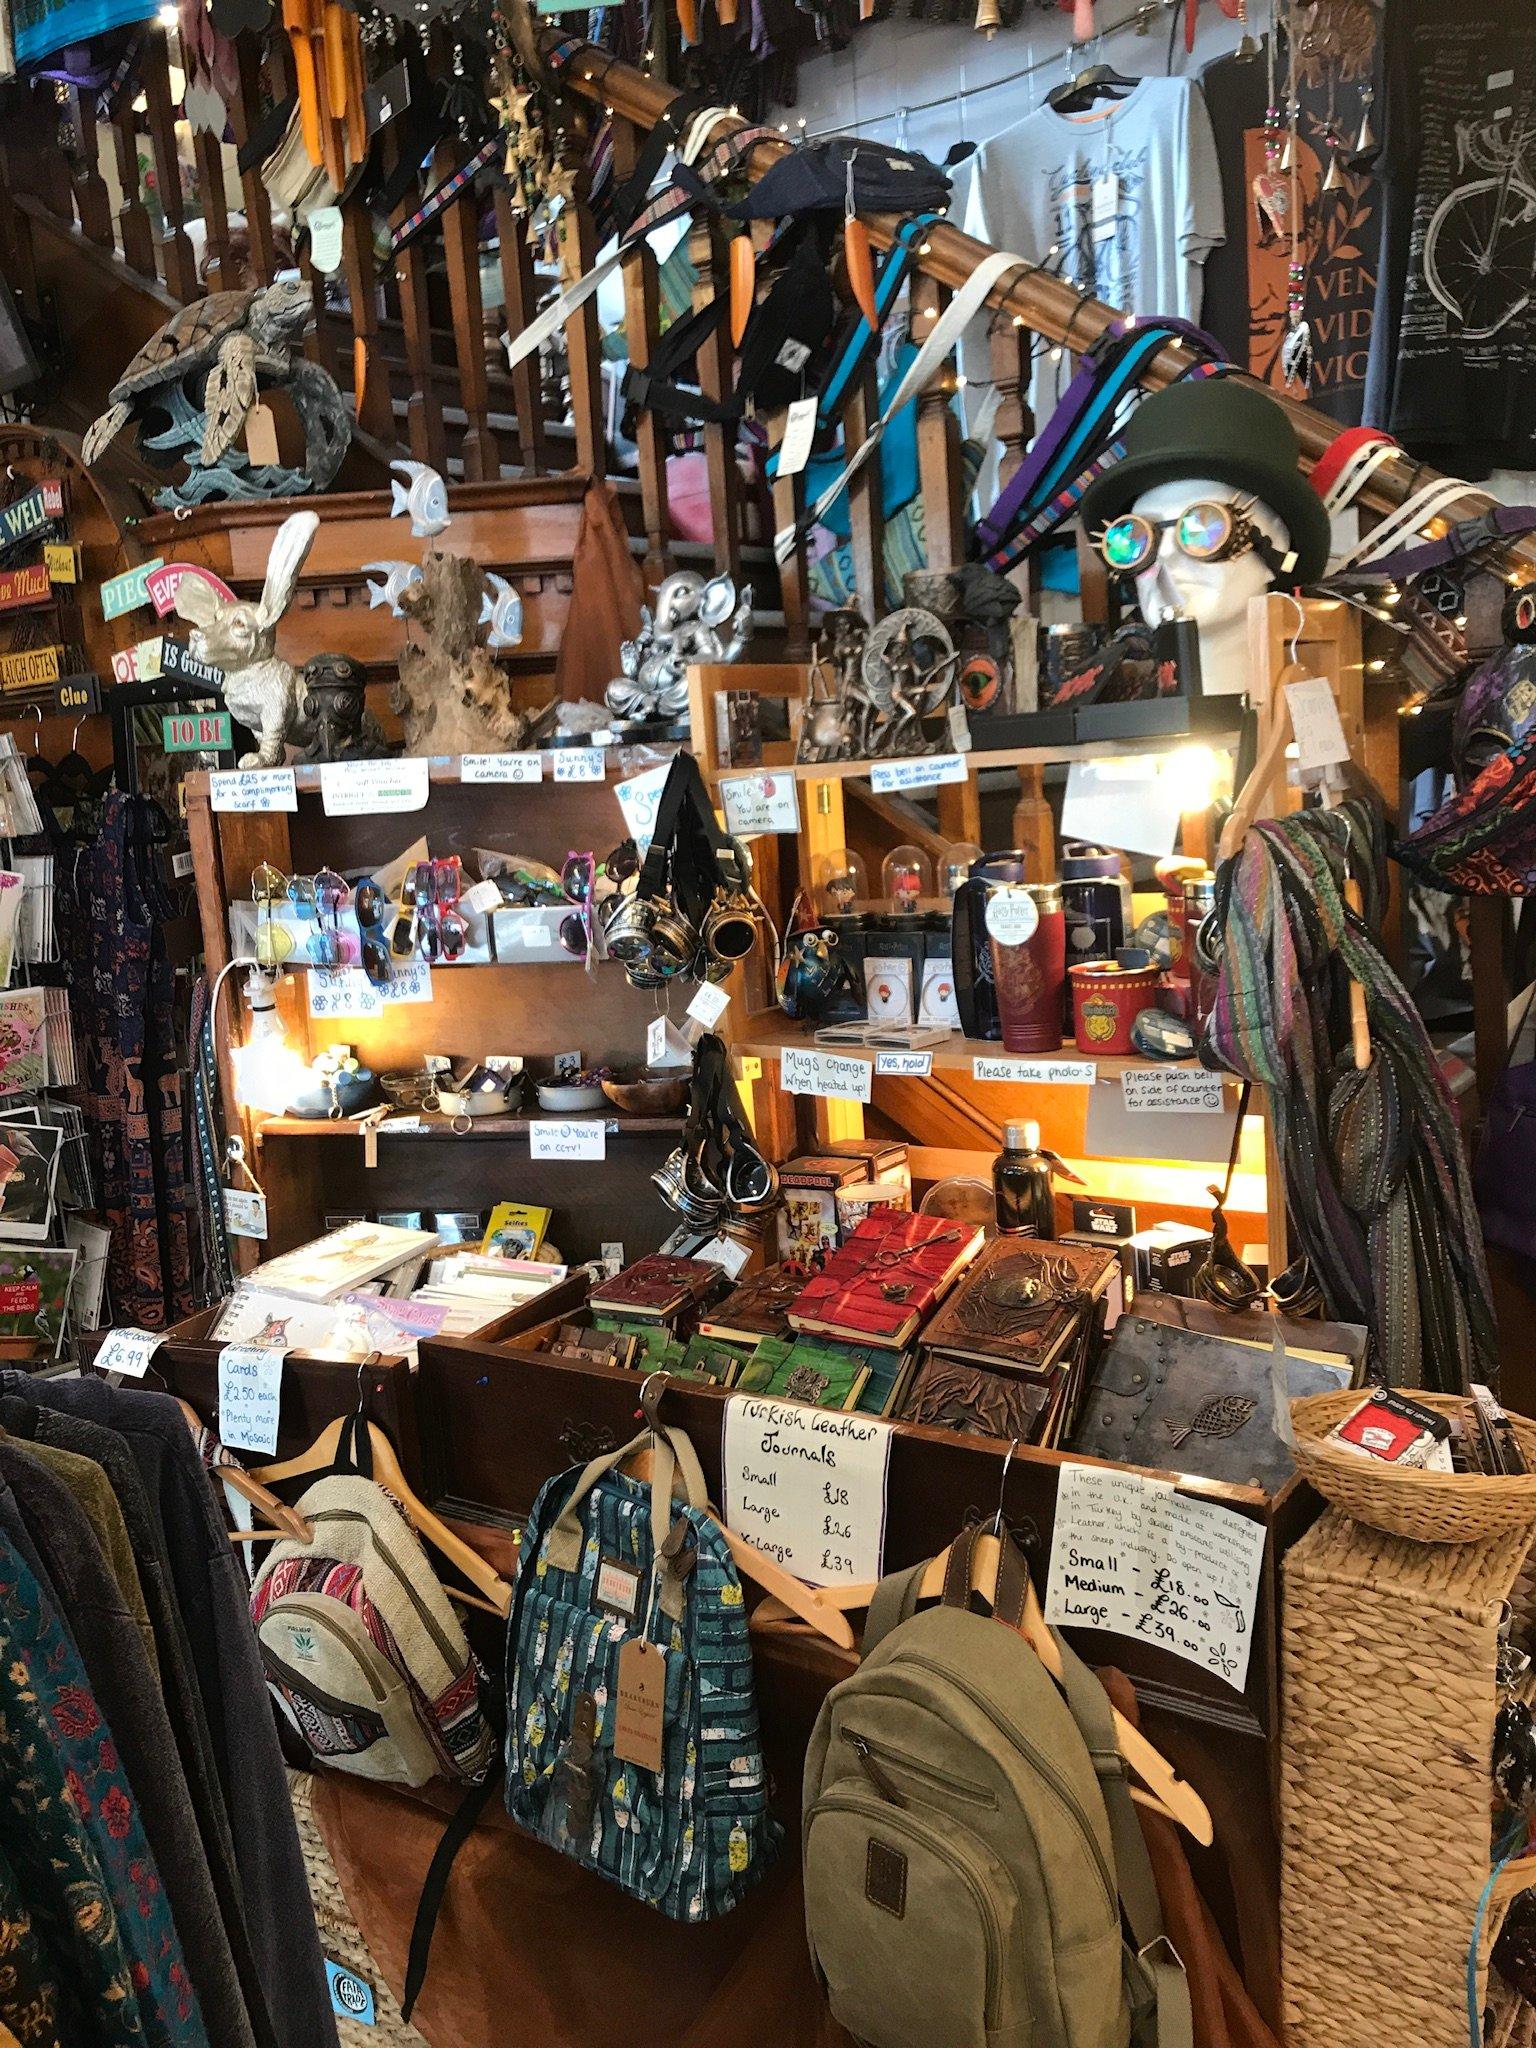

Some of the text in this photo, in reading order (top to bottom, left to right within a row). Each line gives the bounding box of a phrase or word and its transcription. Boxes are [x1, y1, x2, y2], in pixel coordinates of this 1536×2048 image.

[1314, 266, 1377, 300] VEN
[1314, 308, 1374, 343] VID
[1314, 350, 1370, 385] VIC
[14, 570, 50, 597] Much
[104, 573, 149, 614] PIEC
[164, 643, 179, 669] IS
[1, 651, 57, 688] LAUGH OFTEN
[60, 687, 88, 707] Clue
[170, 716, 226, 745] TO BE
[527, 759, 540, 767] on
[211, 776, 237, 789] Spend
[239, 773, 259, 786] £25
[273, 773, 292, 782] more
[475, 769, 508, 779] camera
[882, 779, 894, 788] for
[215, 789, 225, 800] for
[736, 801, 790, 815] You are on
[738, 817, 775, 826] camera
[392, 964, 427, 982] unny's
[785, 1051, 866, 1079] Mugs change
[902, 1056, 925, 1069] hold
[977, 1060, 1012, 1078] Please
[1017, 1065, 1042, 1079] take
[785, 1073, 868, 1097] When heated up!
[1125, 1070, 1213, 1085] Please push bell
[1125, 1088, 1138, 1096] on
[1166, 1084, 1179, 1094] of
[1181, 1084, 1222, 1093] counter
[1128, 1097, 1201, 1108] for assistance
[573, 1127, 599, 1140] You're
[540, 1143, 551, 1151] on
[780, 1174, 834, 1188] DEADPOOL
[1091, 1217, 1116, 1227] STAR
[1091, 1224, 1118, 1234] WARS
[1168, 1250, 1192, 1261] STAR
[1168, 1255, 1193, 1268] WARS
[10, 1296, 28, 1304] FEED
[16, 1303, 35, 1311] BIRDS
[100, 1342, 143, 1367] £6.99
[226, 1359, 258, 1377] Cards
[258, 1392, 278, 1401] each
[226, 1409, 275, 1432] Plenty more
[741, 1399, 877, 1441] Turkish Leather
[228, 1432, 237, 1440] in
[761, 1431, 837, 1467] Journals
[742, 1466, 777, 1486] Small
[823, 1482, 850, 1506] £18
[743, 1496, 780, 1523] Large
[1069, 1469, 1103, 1486] These
[1112, 1480, 1145, 1494] unique
[1200, 1509, 1214, 1520] are
[1223, 1518, 1257, 1542] designed
[1071, 1501, 1080, 1510] in
[1087, 1503, 1122, 1521] Turkey
[1131, 1512, 1142, 1527] by
[823, 1515, 851, 1538] £26
[1071, 1487, 1080, 1496] in
[1088, 1492, 1103, 1500] the
[1141, 1503, 1157, 1513] and
[1165, 1510, 1190, 1525] made
[1195, 1522, 1205, 1531] at
[1212, 1531, 1252, 1556] workshops
[1069, 1532, 1083, 1541] the
[1091, 1535, 1114, 1545] sheep
[1166, 1553, 1177, 1563] Do
[1182, 1562, 1202, 1574] open
[1114, 1524, 1141, 1534] which
[1147, 1530, 1154, 1540] is
[1176, 1540, 1228, 1571] by-product
[820, 1550, 854, 1574] £39
[1068, 1548, 1118, 1572] Small
[1150, 1568, 1209, 1607] £18.00
[1065, 1574, 1125, 1596] Medium
[1150, 1594, 1211, 1632] £26.00
[1065, 1598, 1108, 1625] Large
[1135, 1613, 1199, 1651] £39.00
[343, 1993, 366, 2007] TRADE
